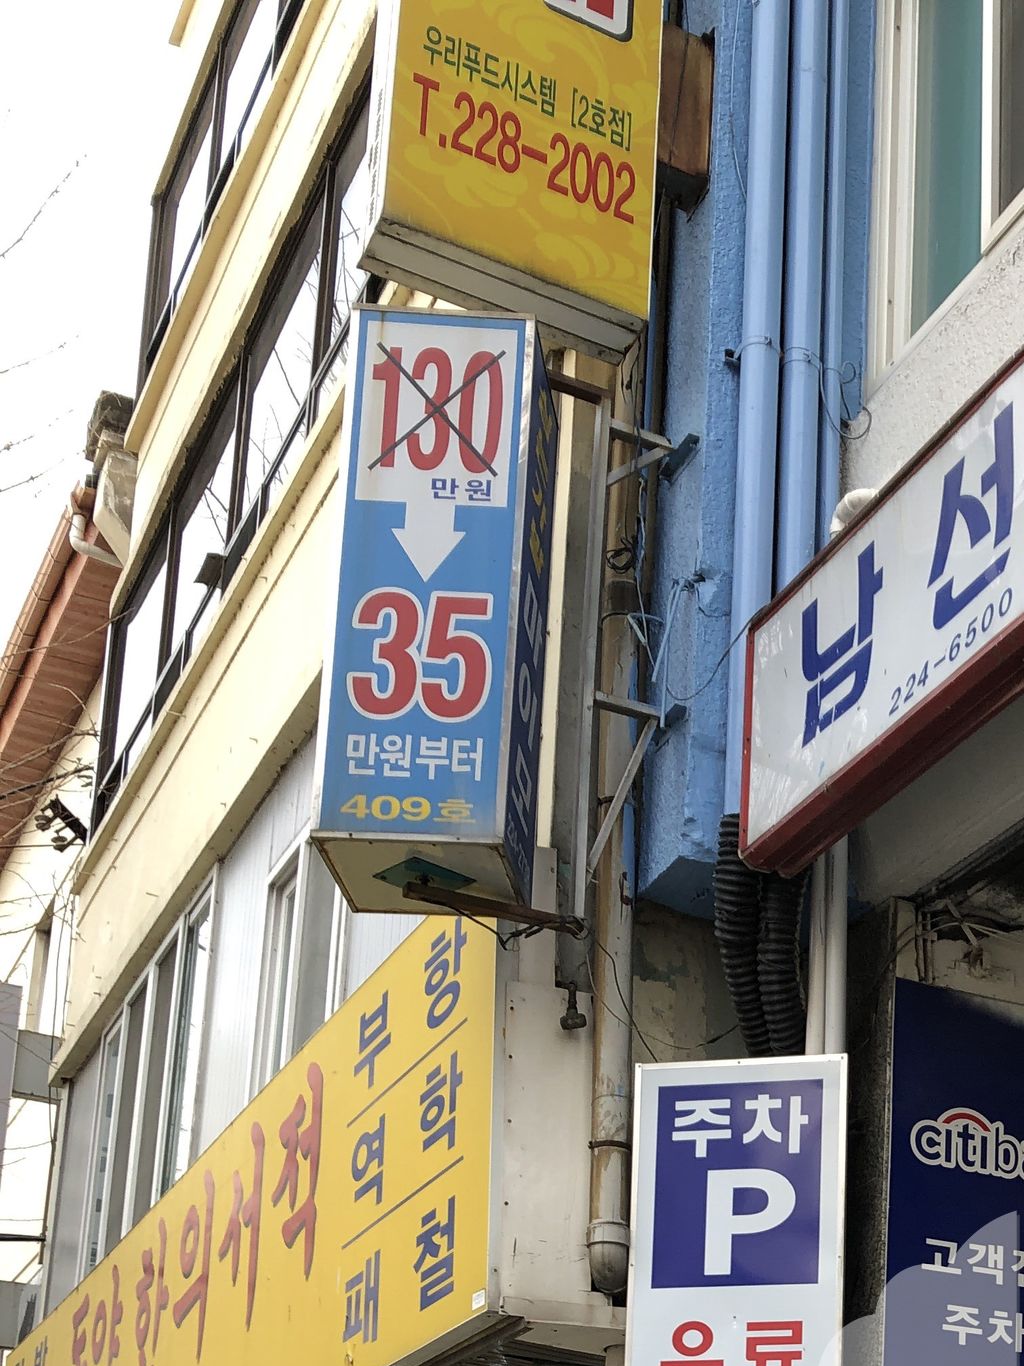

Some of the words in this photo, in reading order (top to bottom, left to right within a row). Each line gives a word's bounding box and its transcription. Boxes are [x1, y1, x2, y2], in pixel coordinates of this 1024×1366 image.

[412, 72, 636, 223] T.228-2002
[423, 25, 557, 118] 우리푸드시스템
[571, 87, 632, 151] [2호점]
[372, 346, 503, 474] 130
[431, 477, 493, 501] 만원
[347, 587, 493, 722] 35
[889, 587, 1012, 716] 224-6500
[346, 734, 483, 781] 만원부터
[672, 1094, 808, 1157] 주차
[704, 1168, 796, 1276] P
